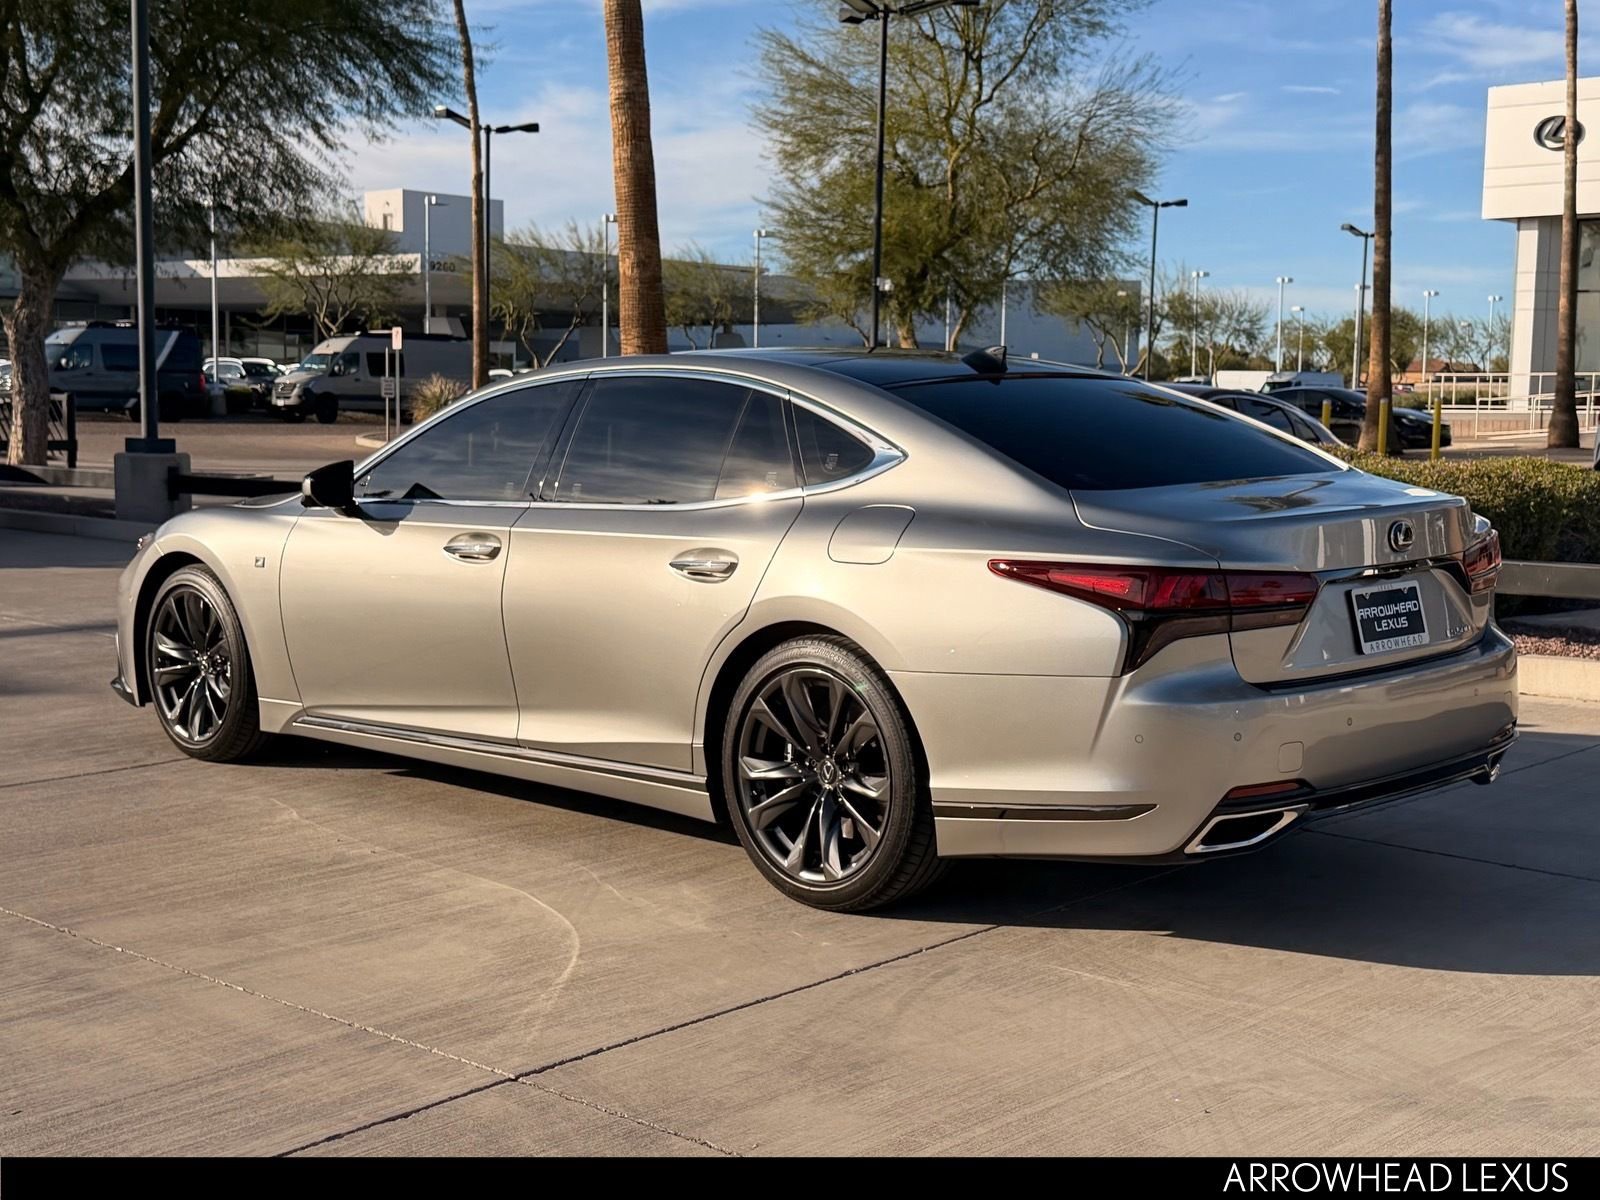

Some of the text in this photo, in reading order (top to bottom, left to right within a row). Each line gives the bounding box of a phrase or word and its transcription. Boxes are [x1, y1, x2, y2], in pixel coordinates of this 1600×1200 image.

[1358, 600, 1420, 620] ARROWHEAD
[1374, 616, 1409, 632] LEXUS
[1369, 635, 1424, 653] ARROWHEAD
